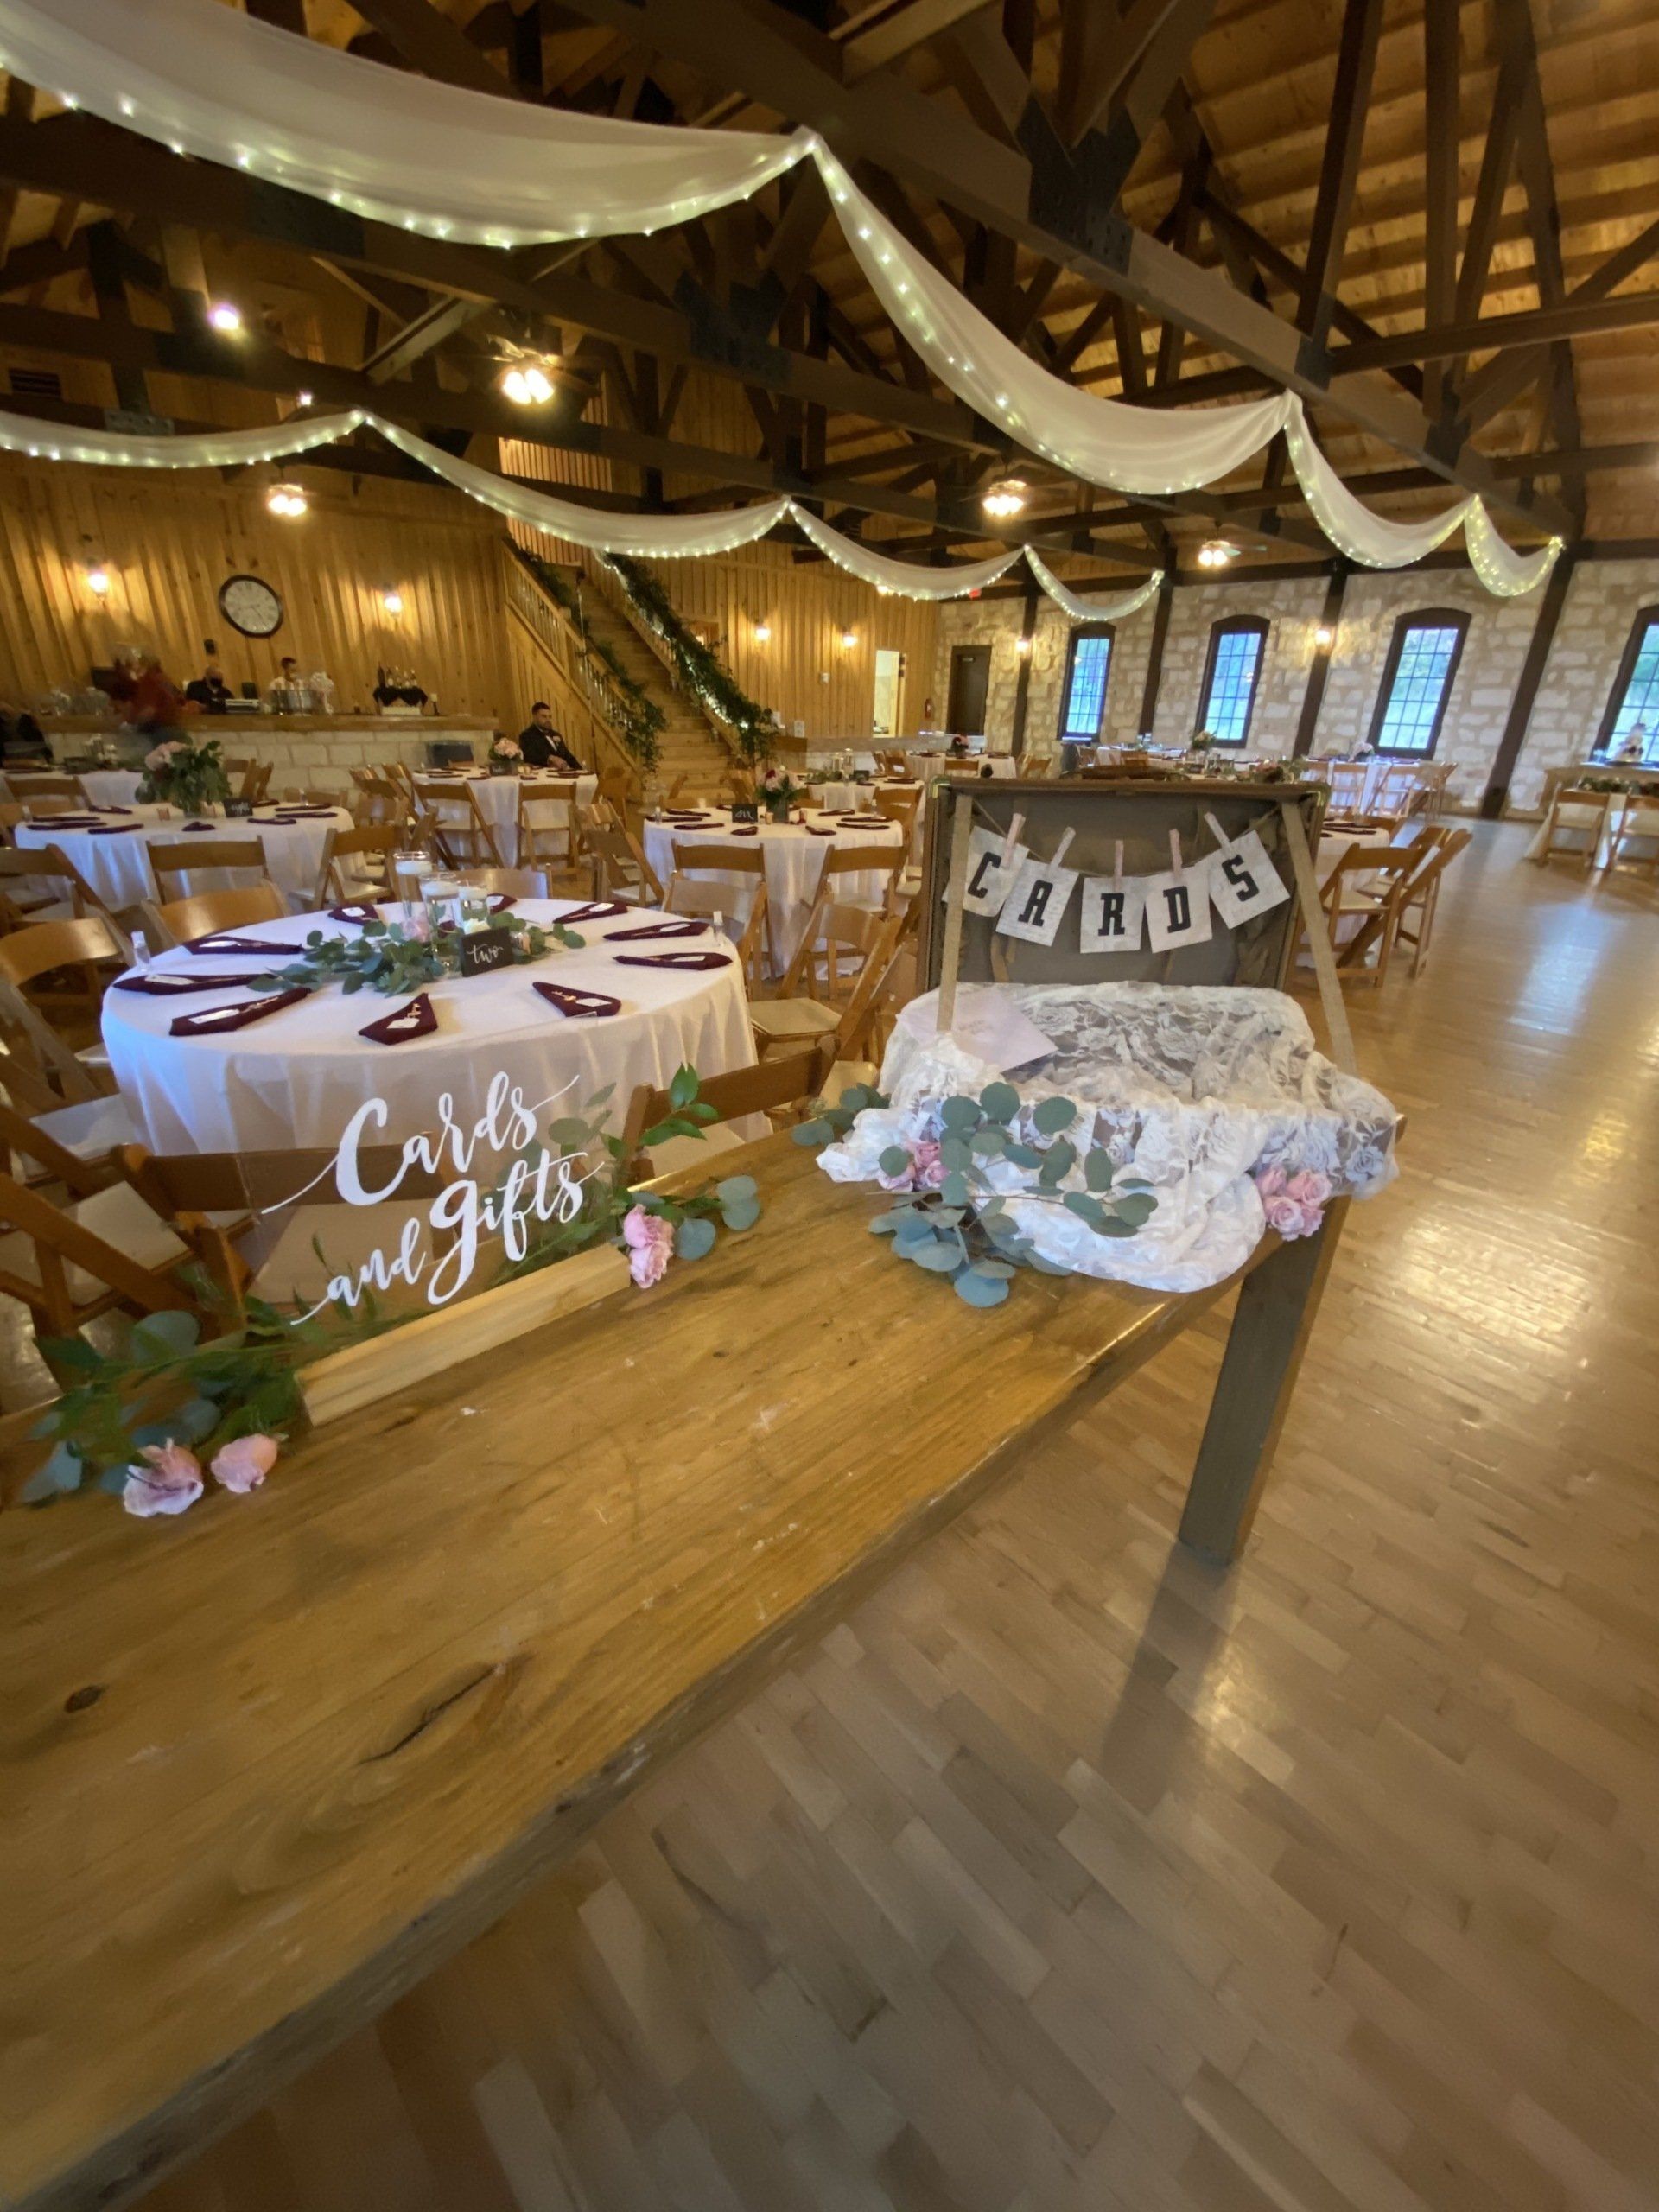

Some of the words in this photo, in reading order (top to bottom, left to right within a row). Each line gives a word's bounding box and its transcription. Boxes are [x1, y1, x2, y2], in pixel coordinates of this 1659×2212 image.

[968, 851, 1260, 936] CARDS
[467, 944, 504, 964] two
[261, 1071, 580, 1214] Cards
[290, 1217, 427, 1325] and
[428, 1149, 605, 1305] gifts
